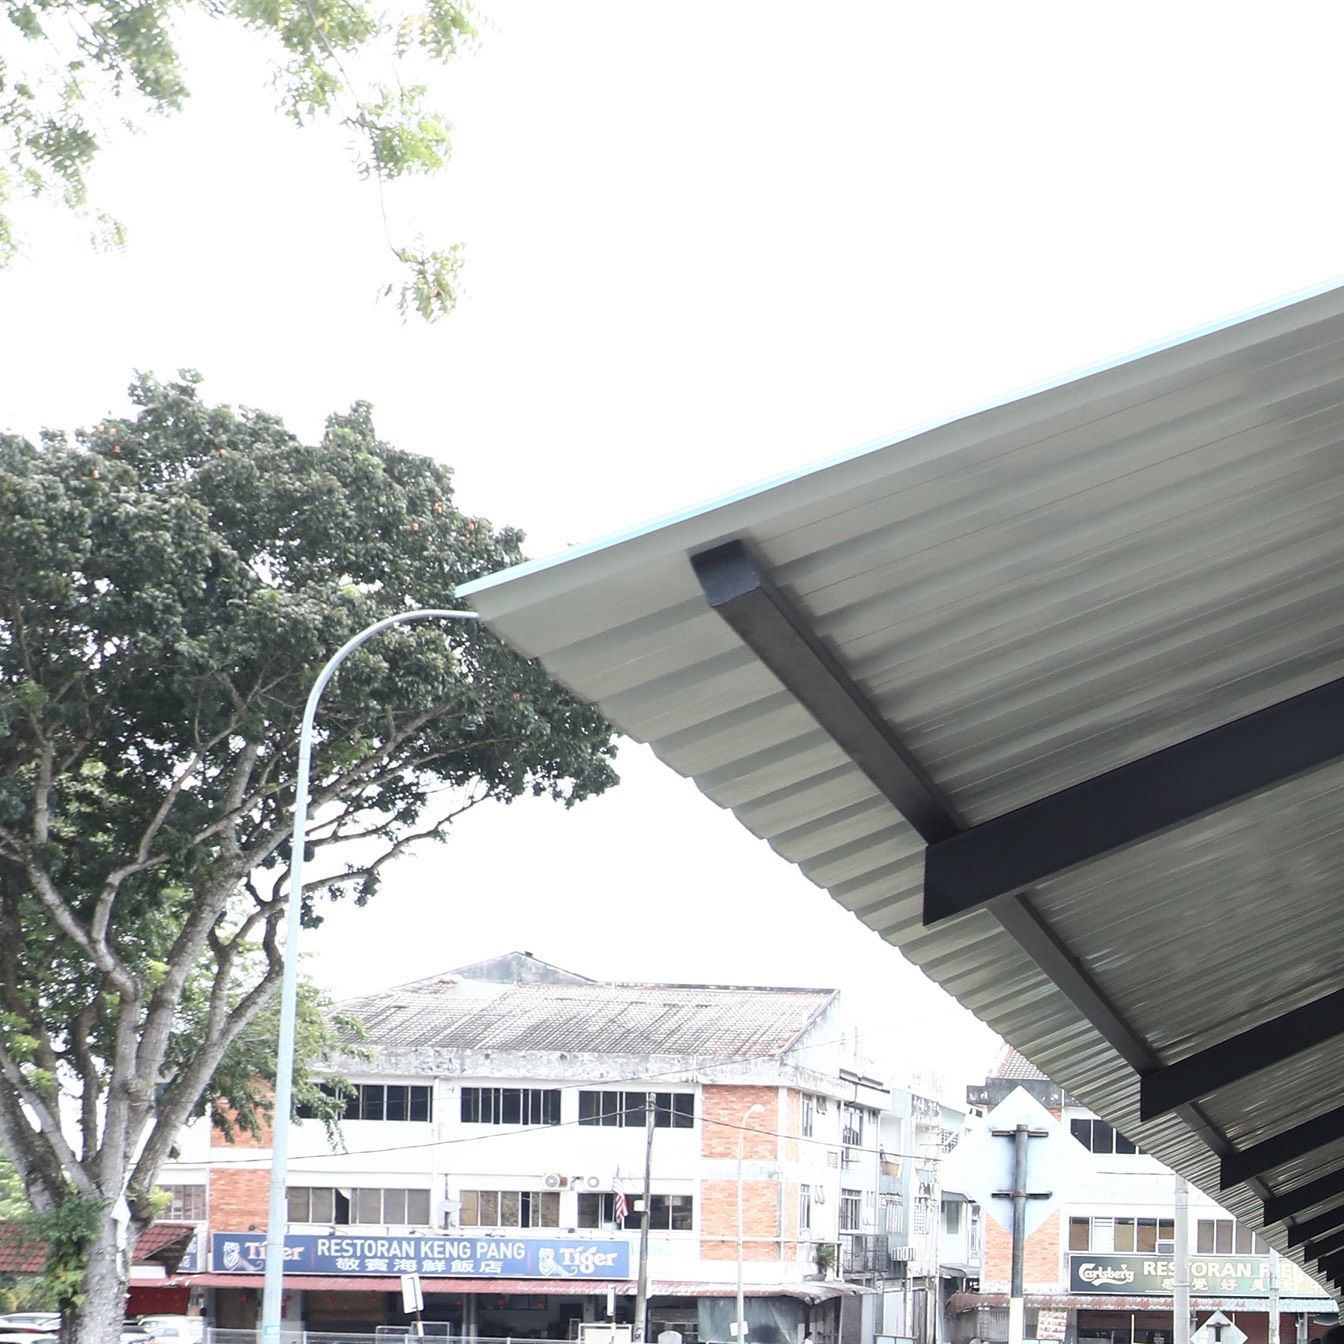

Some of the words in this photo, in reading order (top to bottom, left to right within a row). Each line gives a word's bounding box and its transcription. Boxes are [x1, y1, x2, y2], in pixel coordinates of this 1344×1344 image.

[244, 1240, 305, 1261] Tier
[317, 1239, 414, 1258] RESTORAN
[421, 1241, 471, 1258] KENG
[476, 1242, 526, 1260] PANG
[559, 1245, 618, 1274] Tiger
[1078, 1262, 1135, 1286] Carlsberg
[1143, 1261, 1252, 1278] RESORAN
